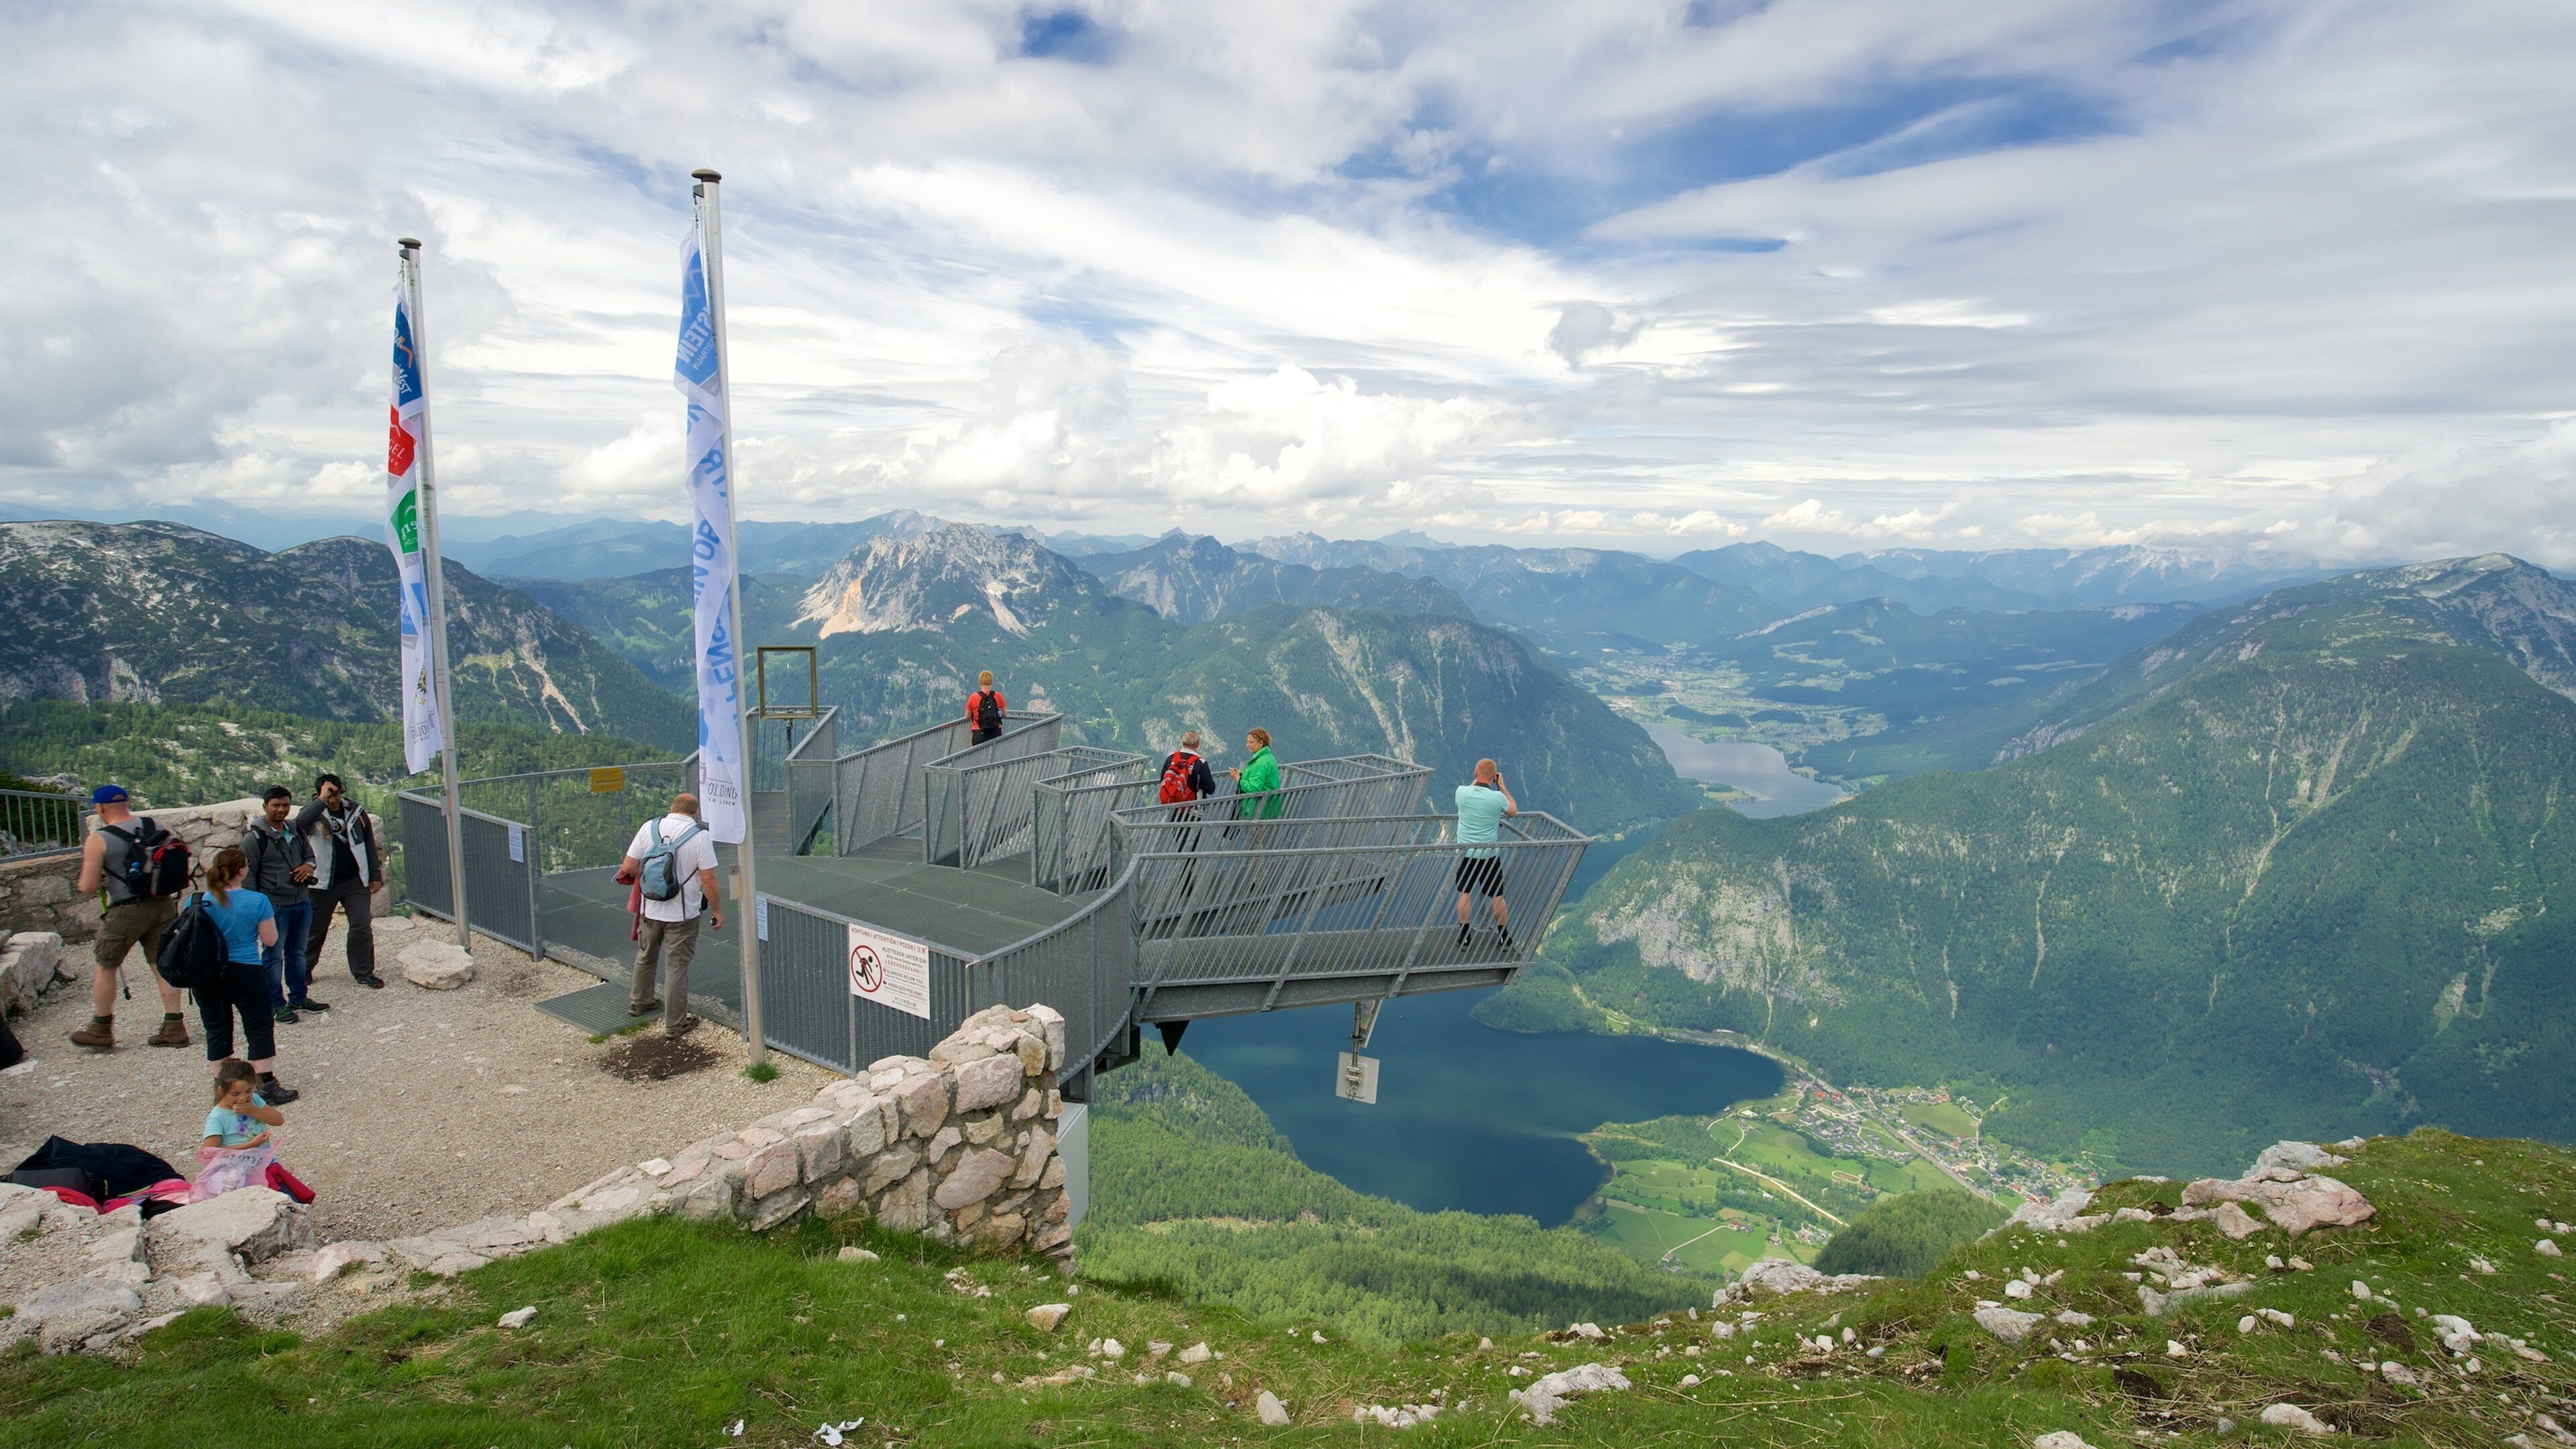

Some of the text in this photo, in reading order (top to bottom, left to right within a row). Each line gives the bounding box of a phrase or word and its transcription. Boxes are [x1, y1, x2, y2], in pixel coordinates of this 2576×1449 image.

[851, 927, 870, 937] ACHTUNG
[900, 941, 913, 950] POZOR
[882, 946, 904, 957] KLETTERER
[905, 953, 918, 961] UNTER
